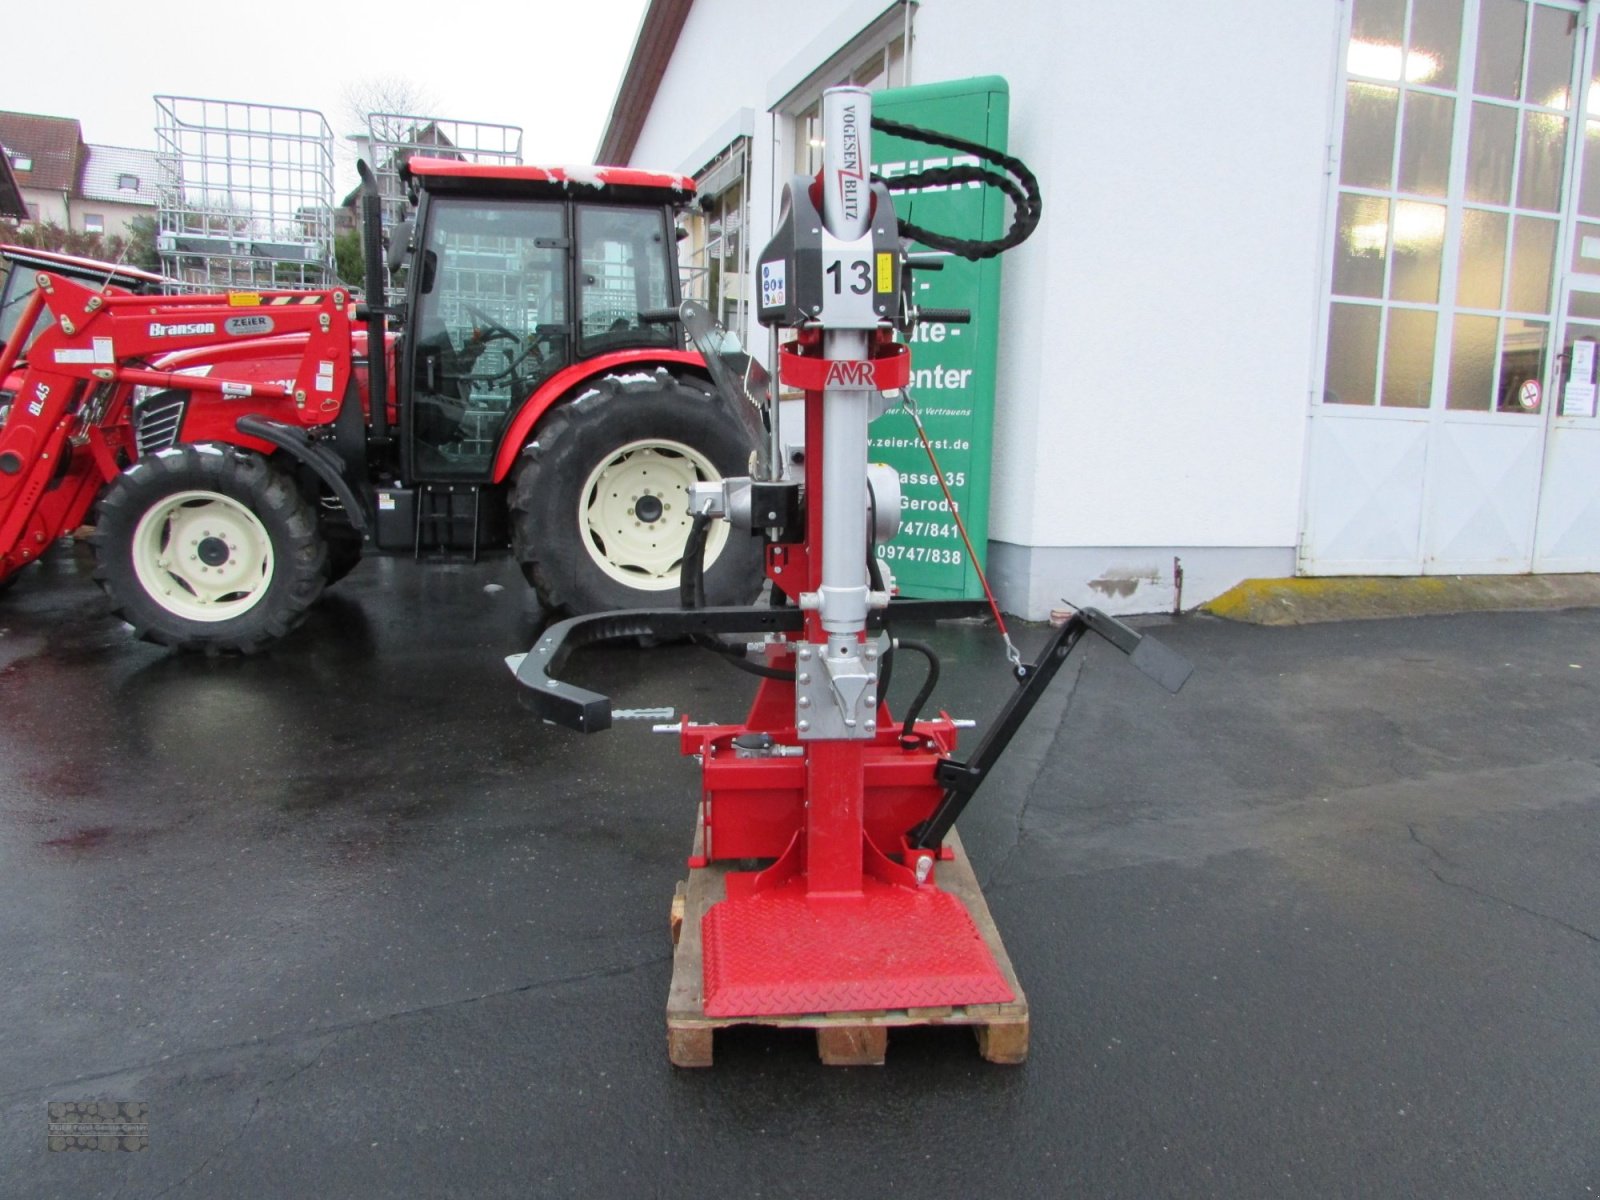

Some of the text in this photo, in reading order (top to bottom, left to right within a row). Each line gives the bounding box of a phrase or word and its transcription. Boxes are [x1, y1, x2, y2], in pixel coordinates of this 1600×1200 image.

[843, 105, 858, 221] VOGESEN BLITZ
[826, 260, 872, 295] 13
[149, 322, 216, 337] Branson
[925, 407, 972, 417] Vertrauens
[867, 437, 969, 450] .zeier-forst.de
[900, 472, 965, 487] asse 35
[877, 545, 961, 565] 09747/838
